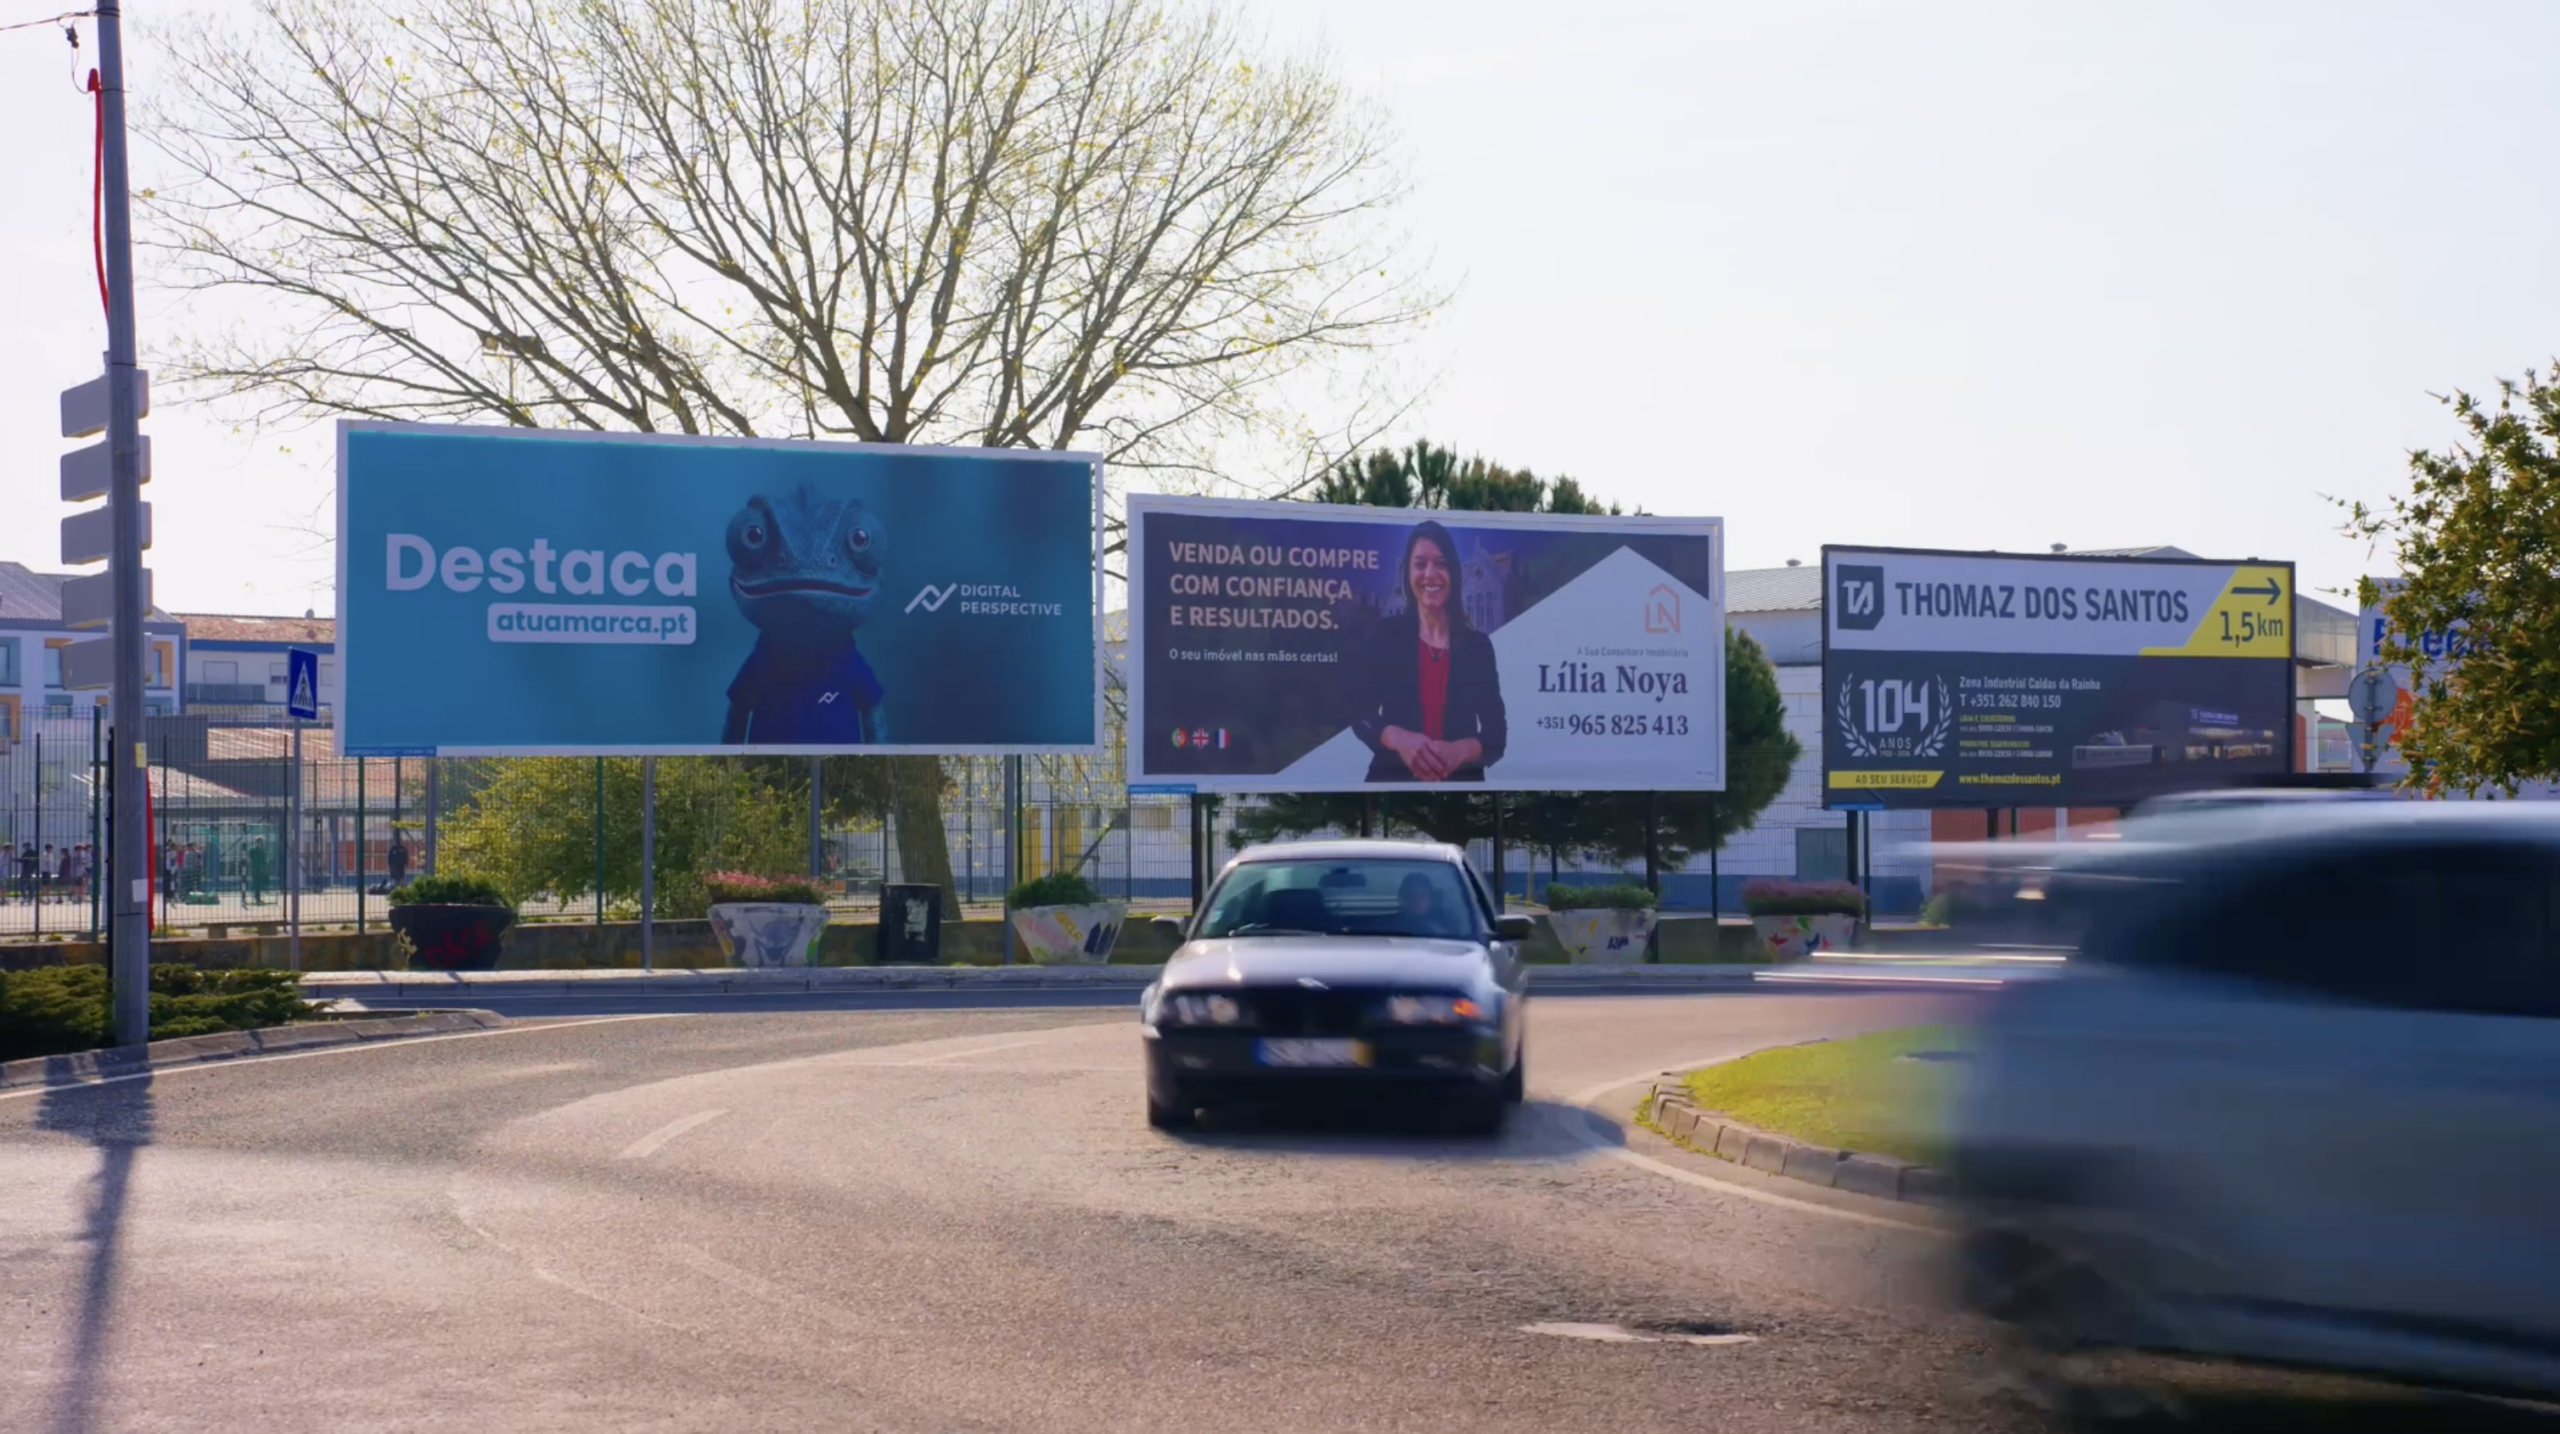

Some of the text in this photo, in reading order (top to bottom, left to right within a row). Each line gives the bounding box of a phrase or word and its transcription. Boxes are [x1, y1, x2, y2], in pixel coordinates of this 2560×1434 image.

[1169, 542, 1379, 569] VENDA OU COMPRE
[386, 534, 696, 597] Destaca
[960, 584, 1021, 598] DIGITAL
[1170, 574, 1352, 605] COM CONFIANÇA
[960, 601, 1063, 616] PERSPECTIVE
[1895, 582, 2189, 623] THOMAZ DOS SANTOS
[497, 612, 688, 639] atuamarca.pt
[1170, 605, 1339, 630] E RESULTADOS.
[1169, 648, 1338, 662] O seu imóvel nas mãos certas!
[1584, 647, 1599, 656] Sua
[1601, 647, 1644, 657] Consultora
[1538, 660, 1688, 703] Lília Noya
[1959, 676, 2101, 690] Zona Industrial Caldas da Rainha
[1860, 679, 1929, 733] 104
[1959, 694, 2061, 708] T +351 262 840 150
[1536, 714, 1689, 735] +351 965 825 413
[1880, 738, 1912, 749] ANOS
[1855, 774, 1868, 785] AO
[1870, 774, 1888, 785] SEU
[1959, 773, 2061, 786] www.thomazdossantos.pt
